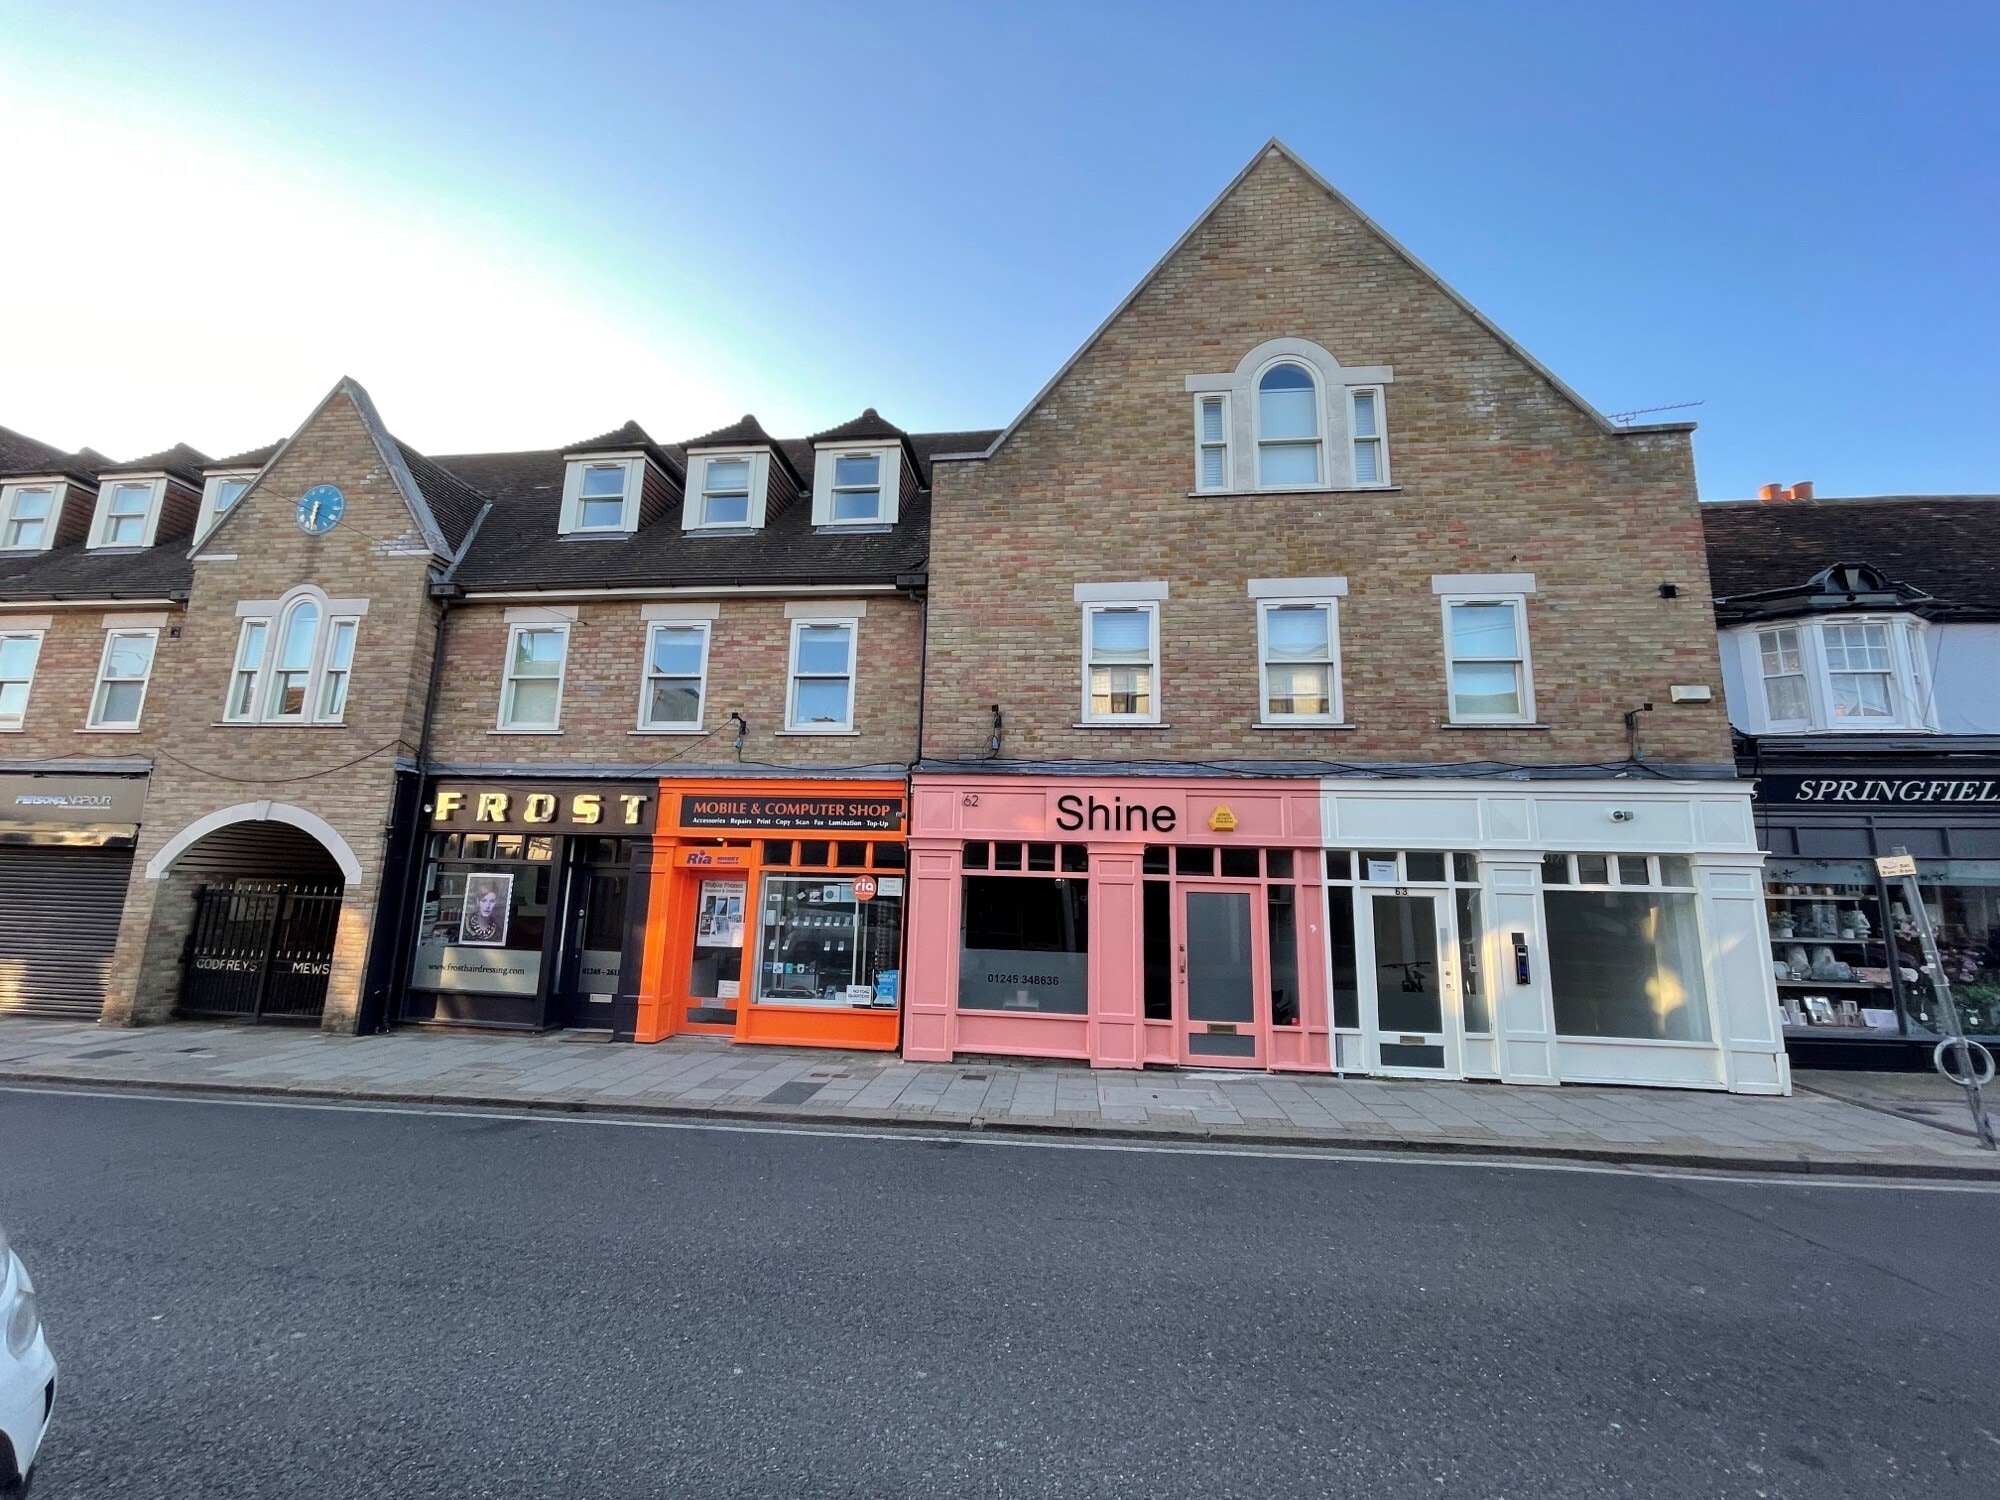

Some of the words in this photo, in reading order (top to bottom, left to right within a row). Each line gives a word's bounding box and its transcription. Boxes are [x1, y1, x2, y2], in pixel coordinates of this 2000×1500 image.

[1795, 780, 2000, 802] SPRINGFIEL
[962, 795, 979, 807] 62
[435, 792, 647, 825] FROST
[693, 802, 747, 814] MOBILE
[750, 803, 761, 815] &
[765, 803, 845, 816] COMPUTER
[848, 804, 891, 817] SHOP
[1056, 794, 1177, 832] Shine
[730, 818, 752, 826] Repairs
[775, 818, 791, 827] Copy
[828, 819, 862, 827] Lamination
[866, 820, 889, 829] Top-Up
[686, 850, 712, 864] Ria
[855, 878, 873, 892] ria
[1395, 887, 1408, 896] 63
[196, 958, 258, 972] GODFREYS
[292, 961, 330, 975] MEWS
[987, 973, 1019, 984] 01245
[1021, 974, 1060, 986] 348636
